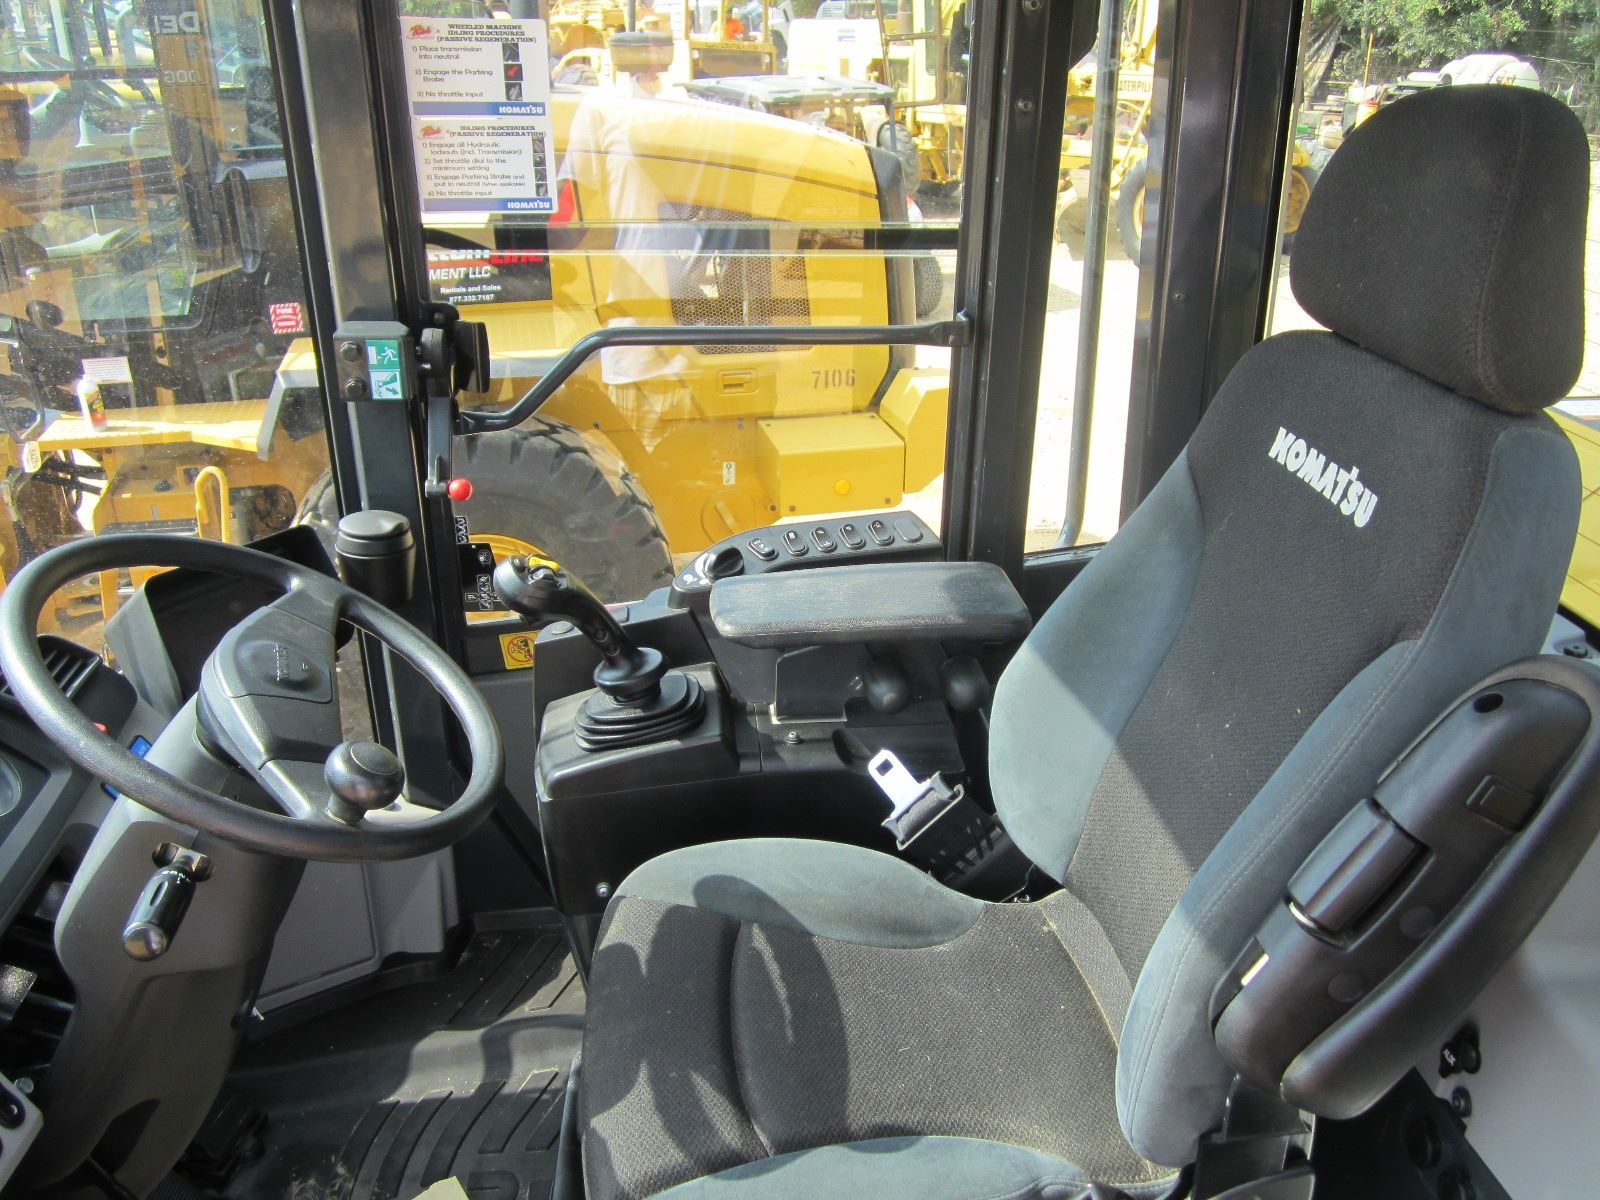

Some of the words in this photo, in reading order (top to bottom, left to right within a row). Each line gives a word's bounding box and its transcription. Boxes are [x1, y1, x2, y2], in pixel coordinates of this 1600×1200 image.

[498, 104, 543, 114] KOMATSU
[433, 173, 460, 181] Engage
[461, 173, 489, 181] Parking
[507, 200, 550, 209] KOMATSU
[468, 265, 491, 279] LLC
[440, 286, 466, 294] Rentals
[811, 368, 856, 389] 7106
[1268, 426, 1378, 528] KOMATSU
